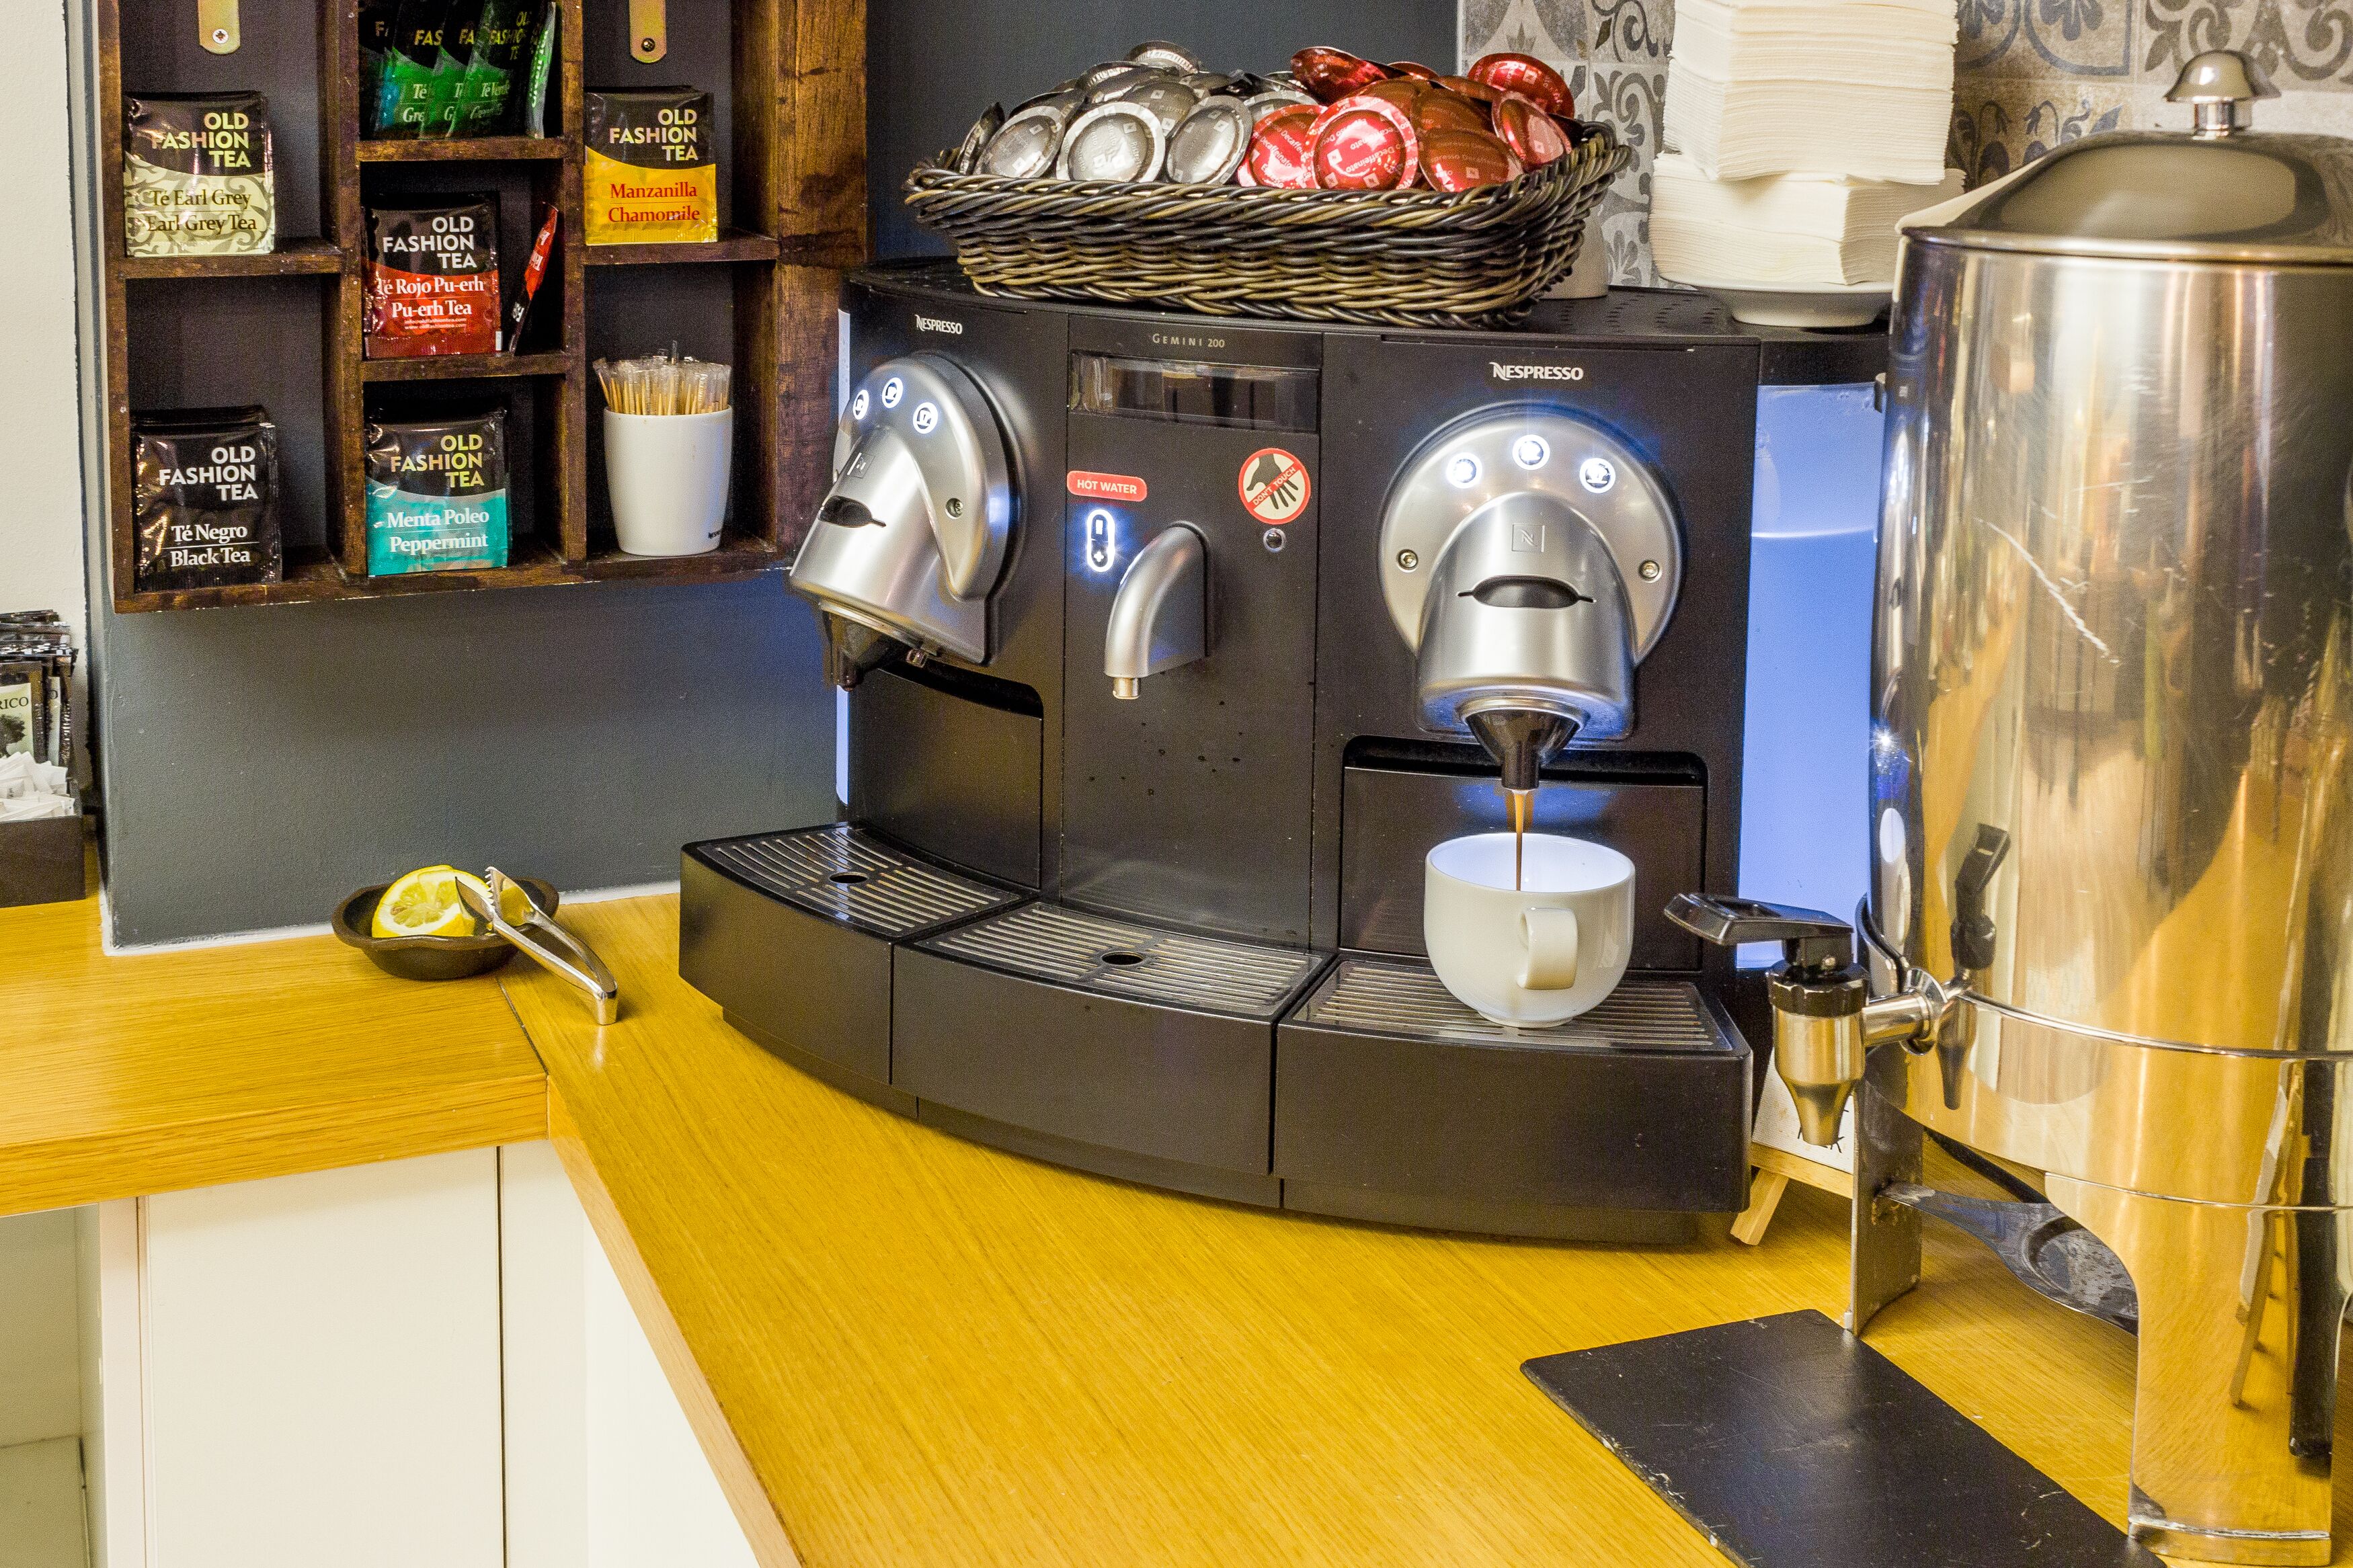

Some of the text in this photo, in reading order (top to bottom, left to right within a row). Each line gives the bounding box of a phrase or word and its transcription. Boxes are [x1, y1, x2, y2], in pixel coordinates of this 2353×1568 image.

[204, 112, 249, 130] OLD
[657, 108, 697, 126] OLD
[151, 131, 249, 149] FASHION
[609, 126, 697, 145] FASHION
[208, 151, 251, 167] TEA
[662, 145, 699, 161] TEA
[1259, 136, 1292, 167] Decaffeinato
[1345, 145, 1395, 173] Decaffeinato
[149, 189, 251, 210] Té Earl Grey
[610, 181, 698, 199] Manzanilla
[608, 205, 701, 222] Chamomile
[147, 214, 257, 235] Earl Grey Tea
[432, 216, 475, 233] OLD
[383, 234, 475, 253] FASHION
[437, 253, 477, 269] TEA
[395, 278, 432, 297] Rojo
[434, 275, 485, 294] Pu-erh
[391, 300, 473, 319] Pu-erh Tea
[914, 314, 963, 335] NESPRESSO
[1152, 333, 1225, 348] GEMINI 200
[1488, 362, 1584, 381] NESPRESSO
[440, 434, 483, 452] OLD
[211, 446, 256, 464] OLD
[390, 452, 483, 473] FASHION
[159, 464, 256, 486] FASHION
[445, 470, 485, 489] TEA
[216, 483, 259, 501] TEA
[1076, 479, 1138, 495] HOT WATER
[1252, 466, 1297, 506] DON'T TOUCH
[386, 507, 490, 529] Menta Poleo
[171, 524, 248, 544] Té Negro
[389, 532, 489, 556] Peppermint
[169, 547, 251, 567] Black Tea
